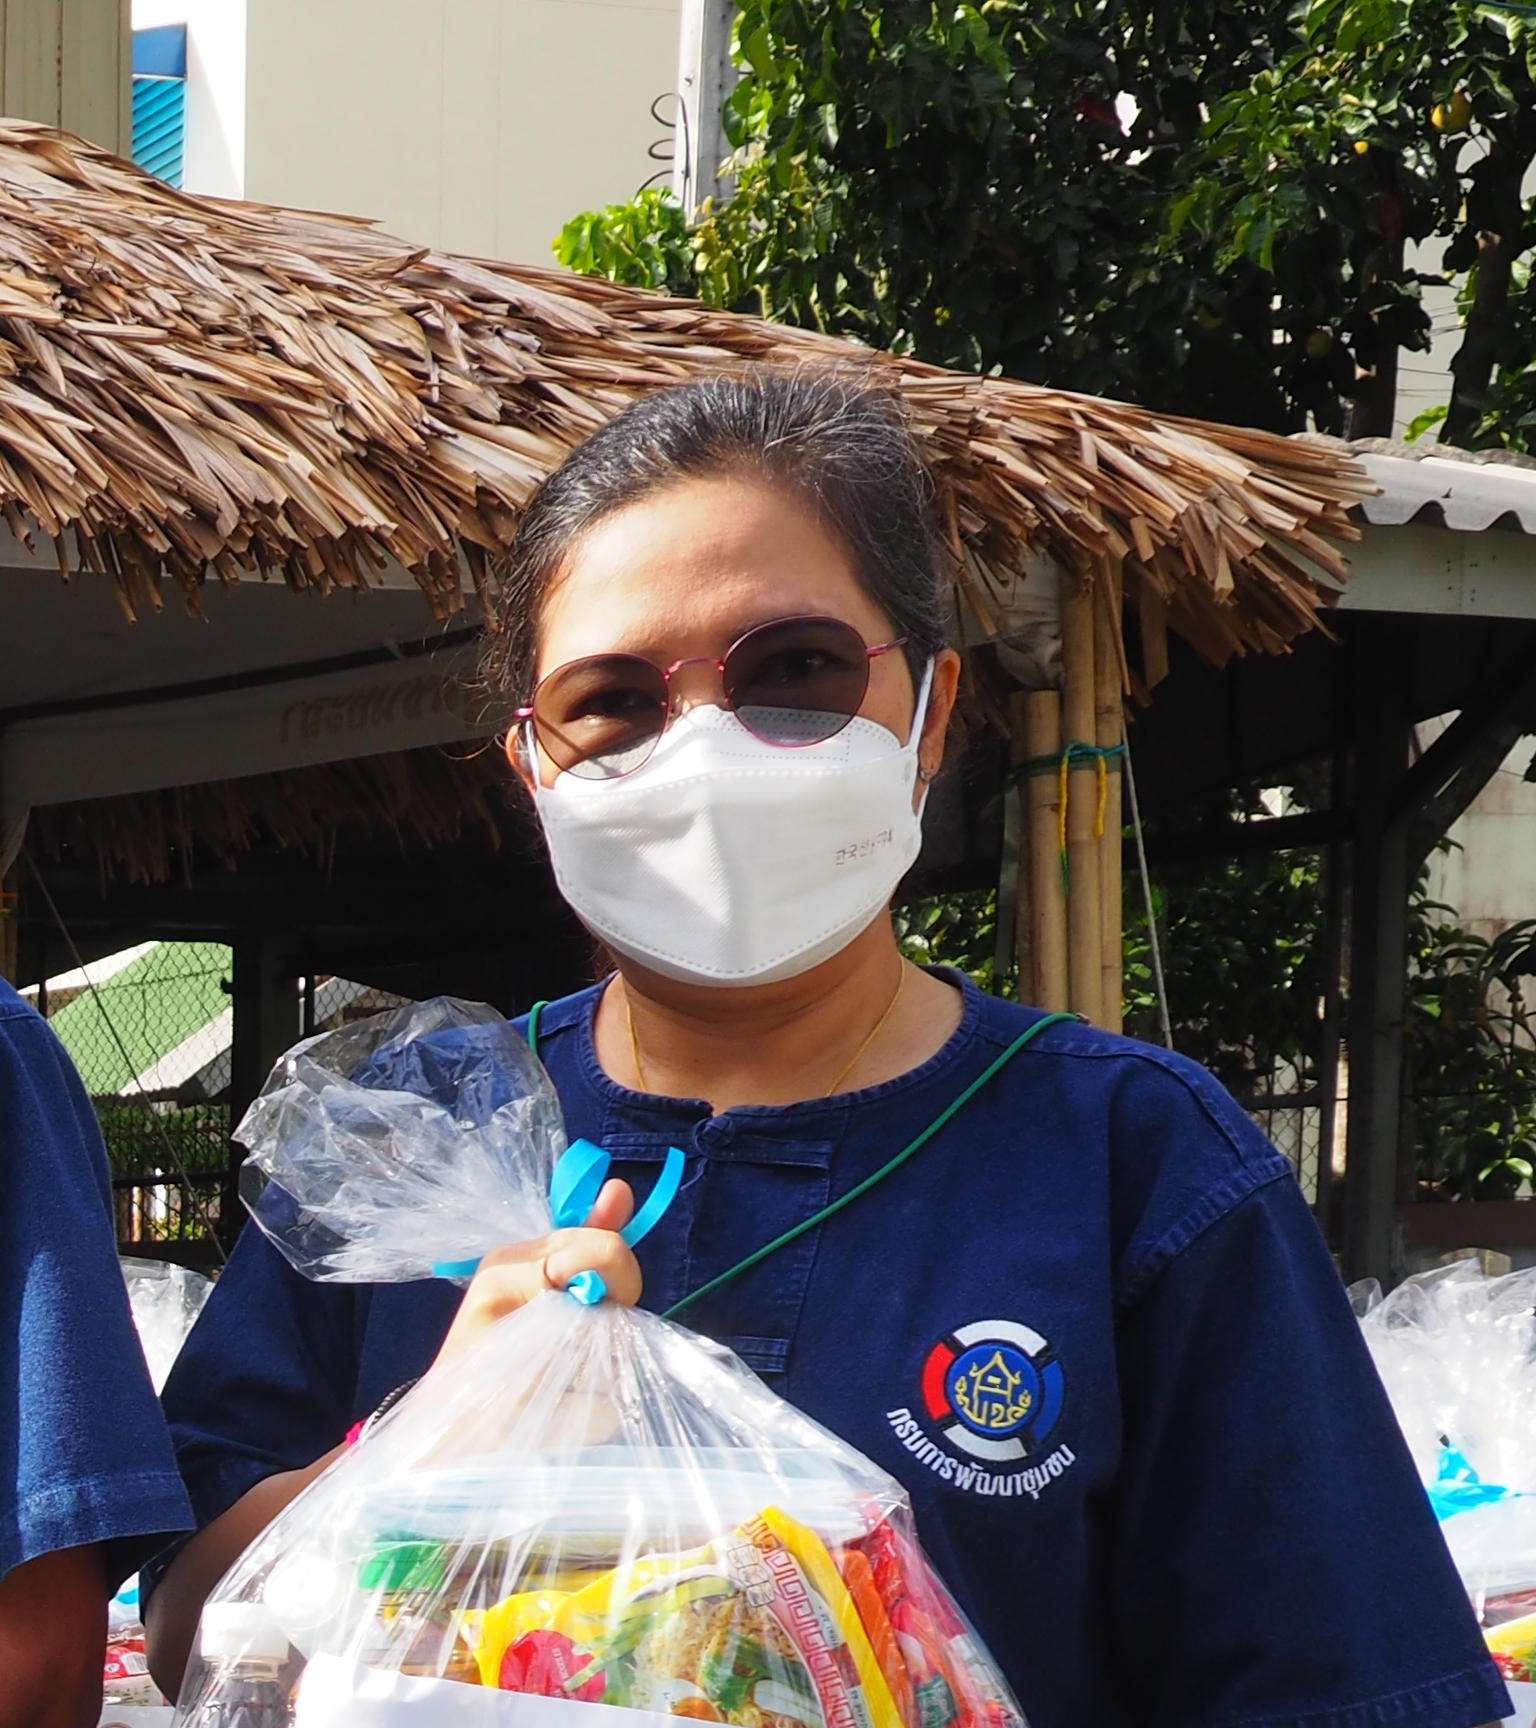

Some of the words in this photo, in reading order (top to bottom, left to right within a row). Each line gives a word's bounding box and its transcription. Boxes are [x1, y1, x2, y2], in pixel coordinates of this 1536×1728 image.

[886, 1407, 1077, 1500] กรมการพัฒนาชุมชน
